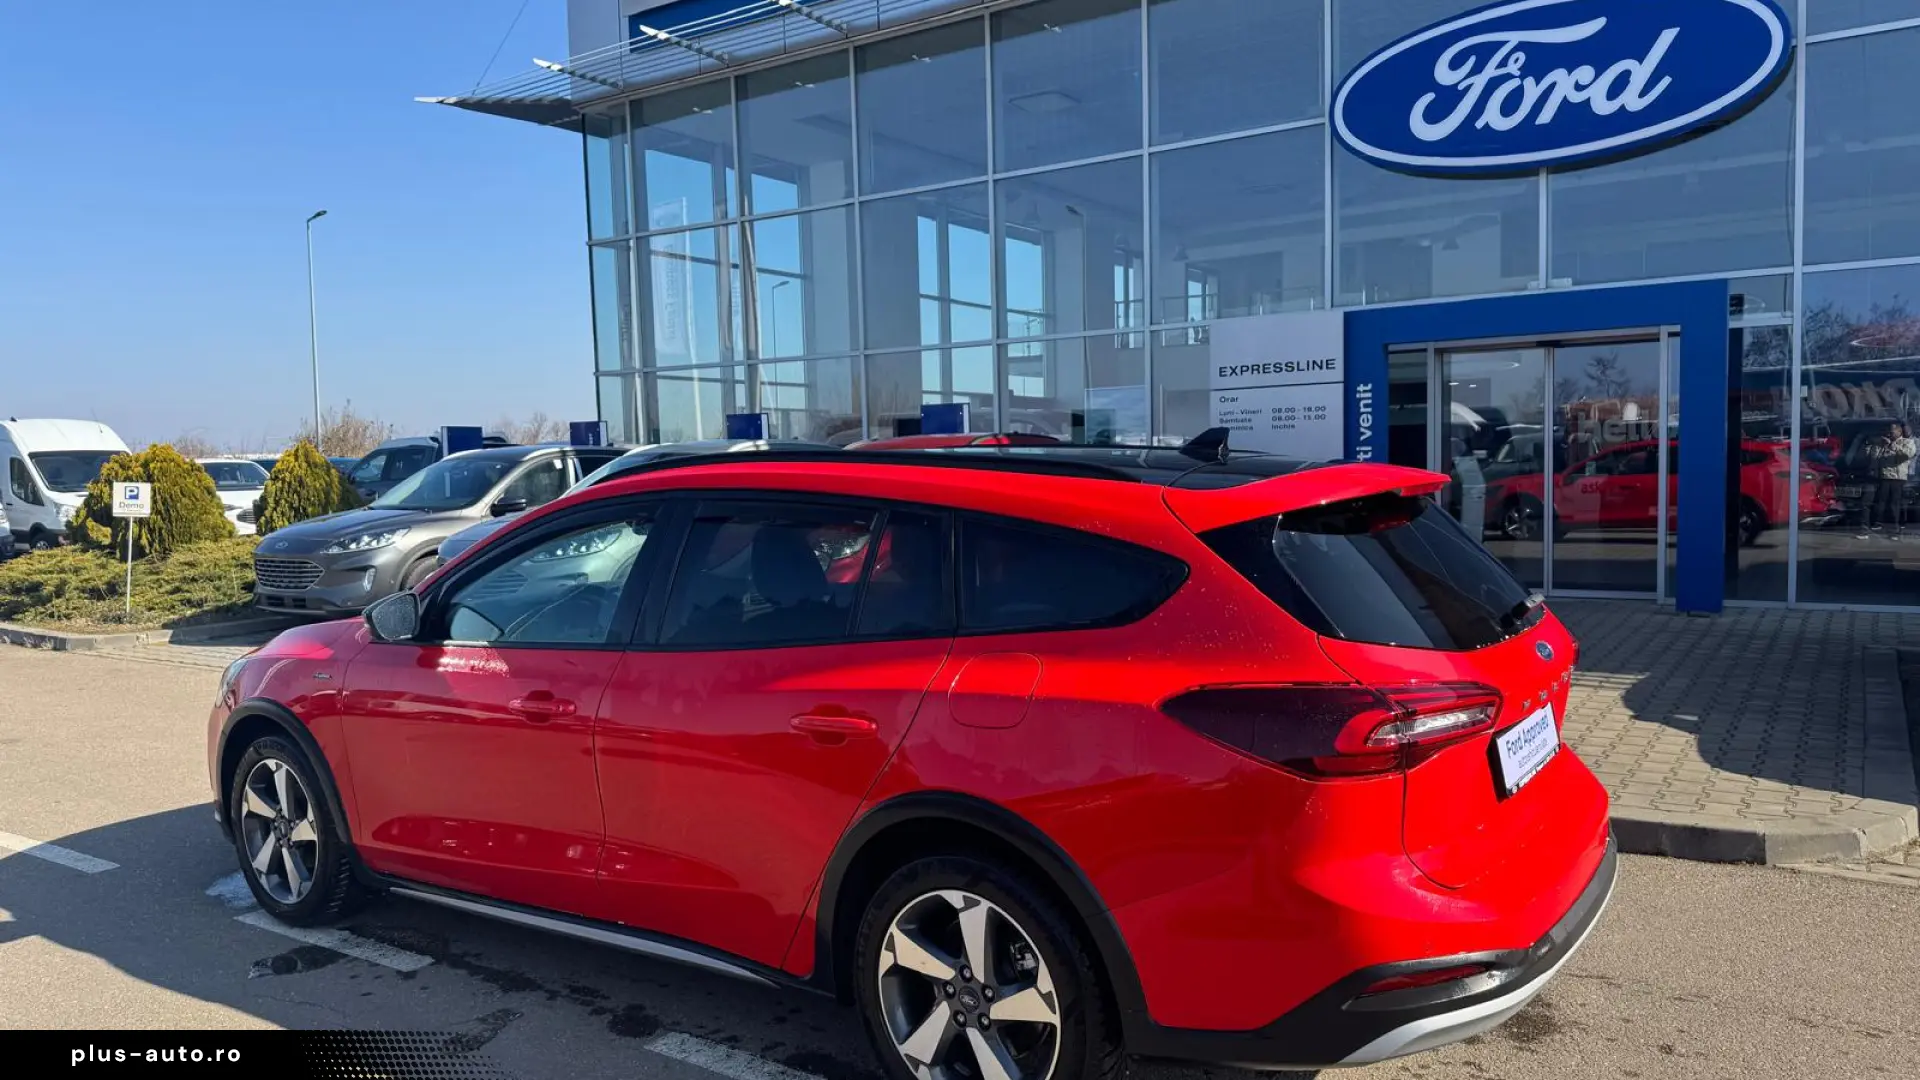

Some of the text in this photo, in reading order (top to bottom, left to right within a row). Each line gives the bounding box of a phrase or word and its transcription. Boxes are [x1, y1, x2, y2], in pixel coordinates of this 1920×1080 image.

[1410, 16, 1680, 141] Ford
[1218, 358, 1336, 377] EXPRESSLINE
[1356, 383, 1372, 442] venit
[1506, 730, 1523, 759] Ford
